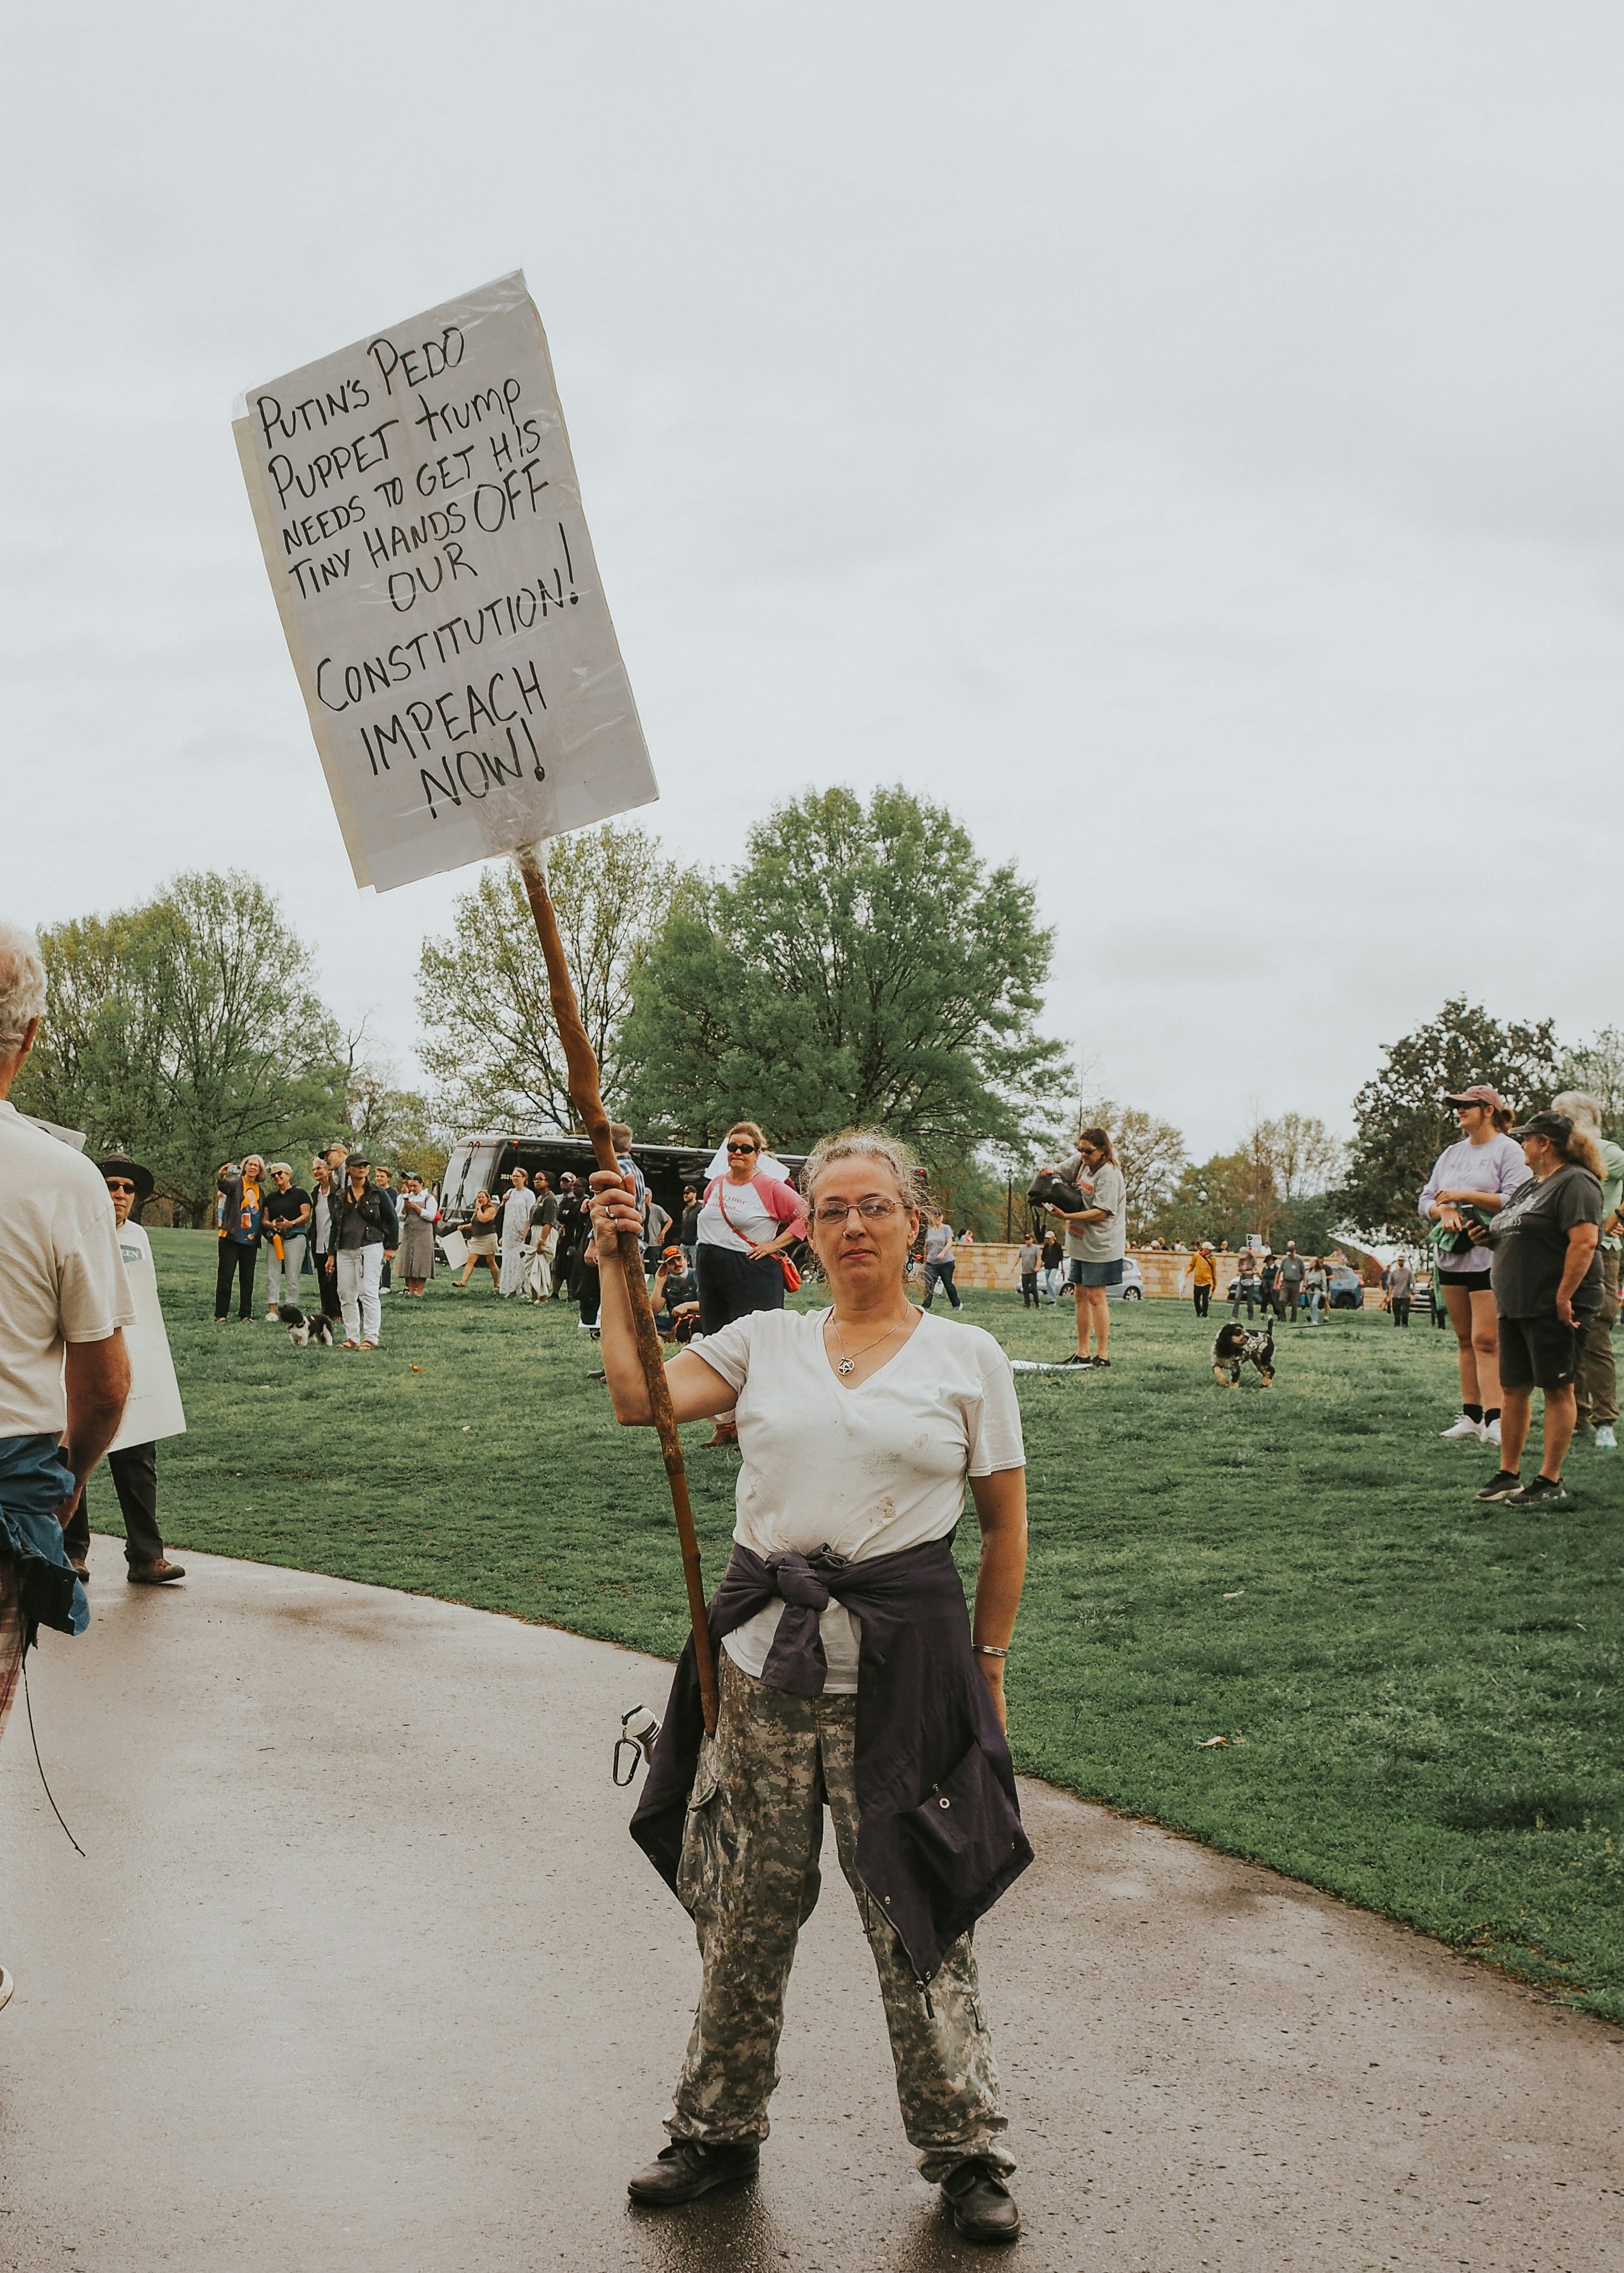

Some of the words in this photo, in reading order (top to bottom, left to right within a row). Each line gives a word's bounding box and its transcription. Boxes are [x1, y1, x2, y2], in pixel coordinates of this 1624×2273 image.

[257, 380, 369, 449] PUTIN'S
[367, 327, 464, 395] PEDO
[268, 419, 399, 510] PUPPET
[415, 379, 521, 443] trump
[283, 495, 365, 555] NEEDS
[374, 477, 403, 508] TO
[417, 445, 474, 496] GET
[490, 420, 540, 472] HIS
[288, 549, 350, 599] TINY
[363, 502, 466, 568] HANDS
[474, 458, 549, 532] OFF
[318, 521, 579, 711] CONSTITUTION!
[388, 542, 478, 612] OUR
[361, 661, 547, 775] IMPEACH
[420, 718, 545, 819] NOW!
